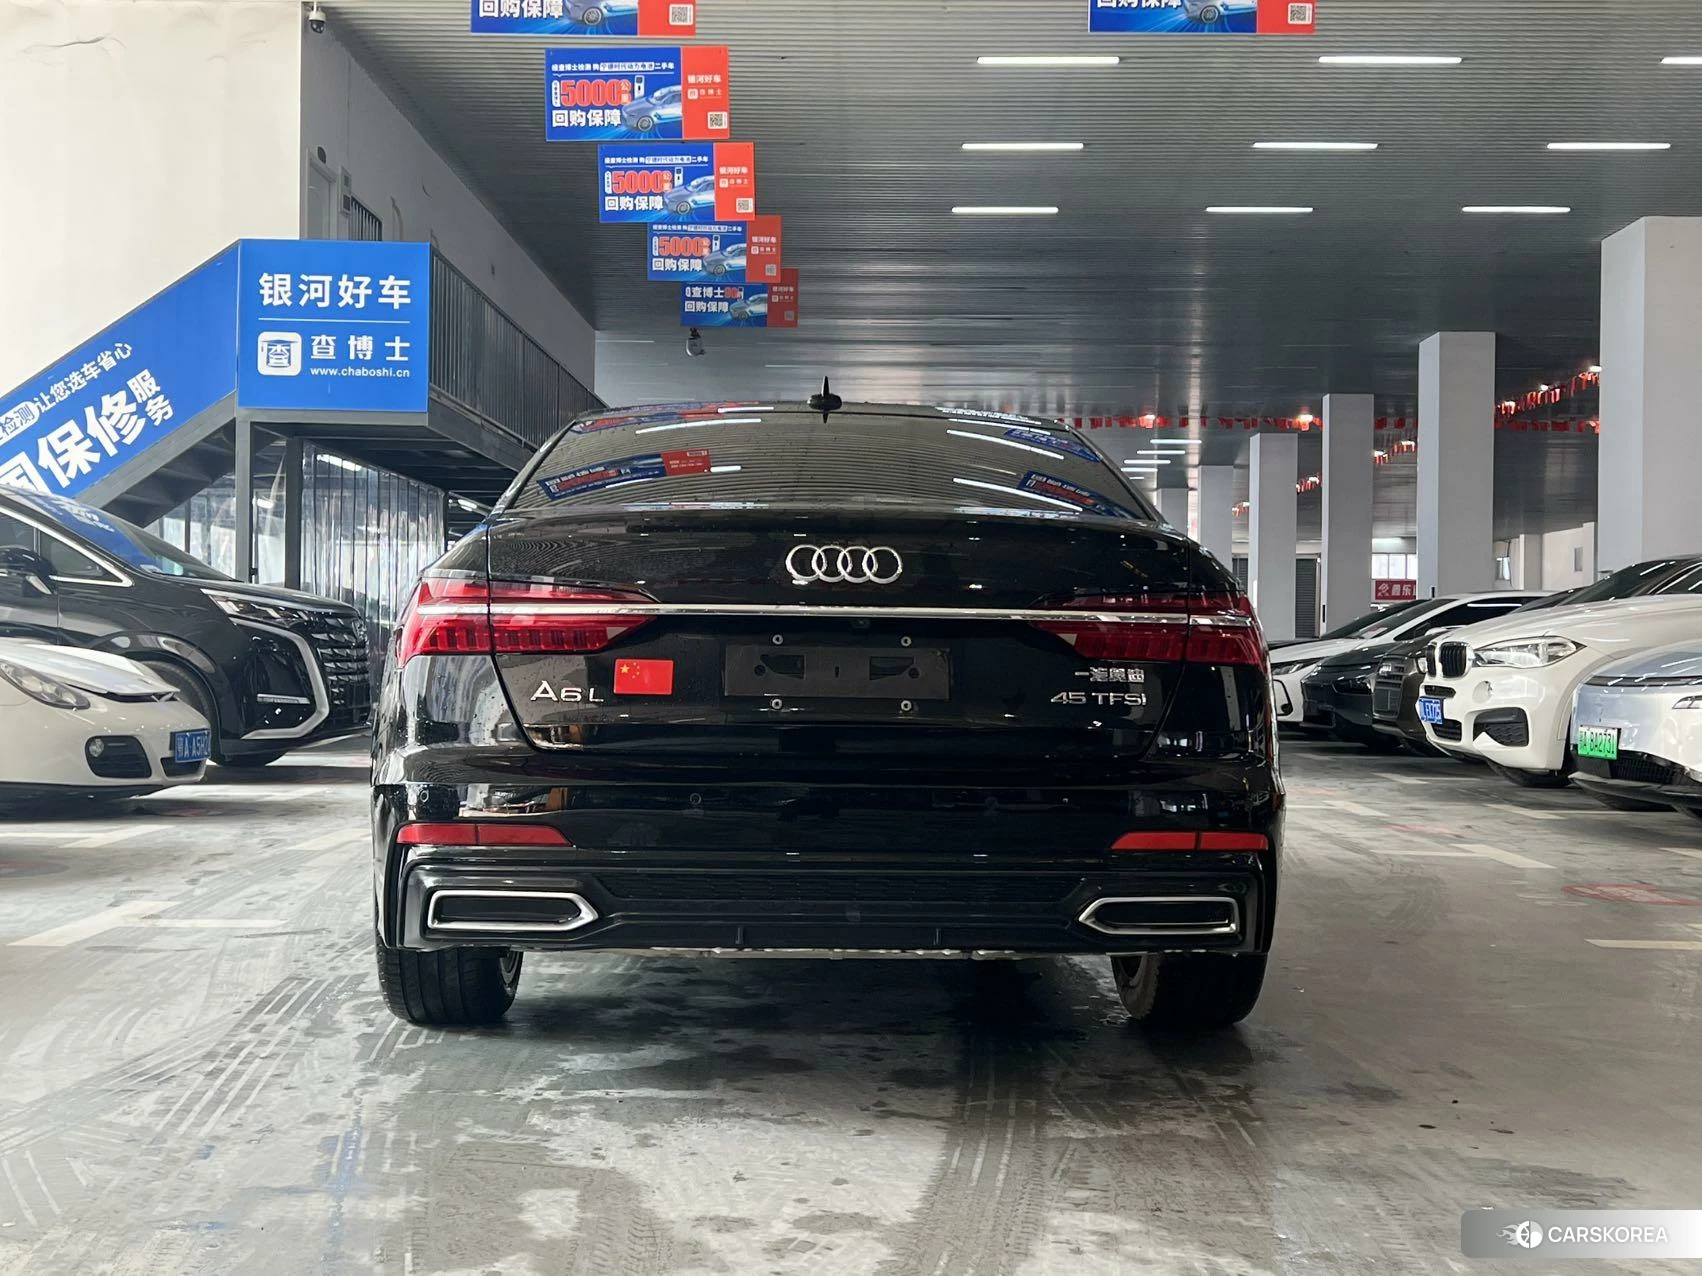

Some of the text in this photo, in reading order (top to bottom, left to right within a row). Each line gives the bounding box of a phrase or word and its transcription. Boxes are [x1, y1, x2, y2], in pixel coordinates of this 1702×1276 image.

[552, 109, 622, 128] 回购保障
[604, 195, 664, 211] 回购保障
[652, 257, 703, 272] 回购保障
[258, 272, 412, 310] 银河好车
[684, 300, 729, 313] 回购保障
[310, 334, 411, 362] 查博士
[310, 366, 411, 378] www.chaboshi.cn
[1050, 691, 1147, 706] 45 TFSI
